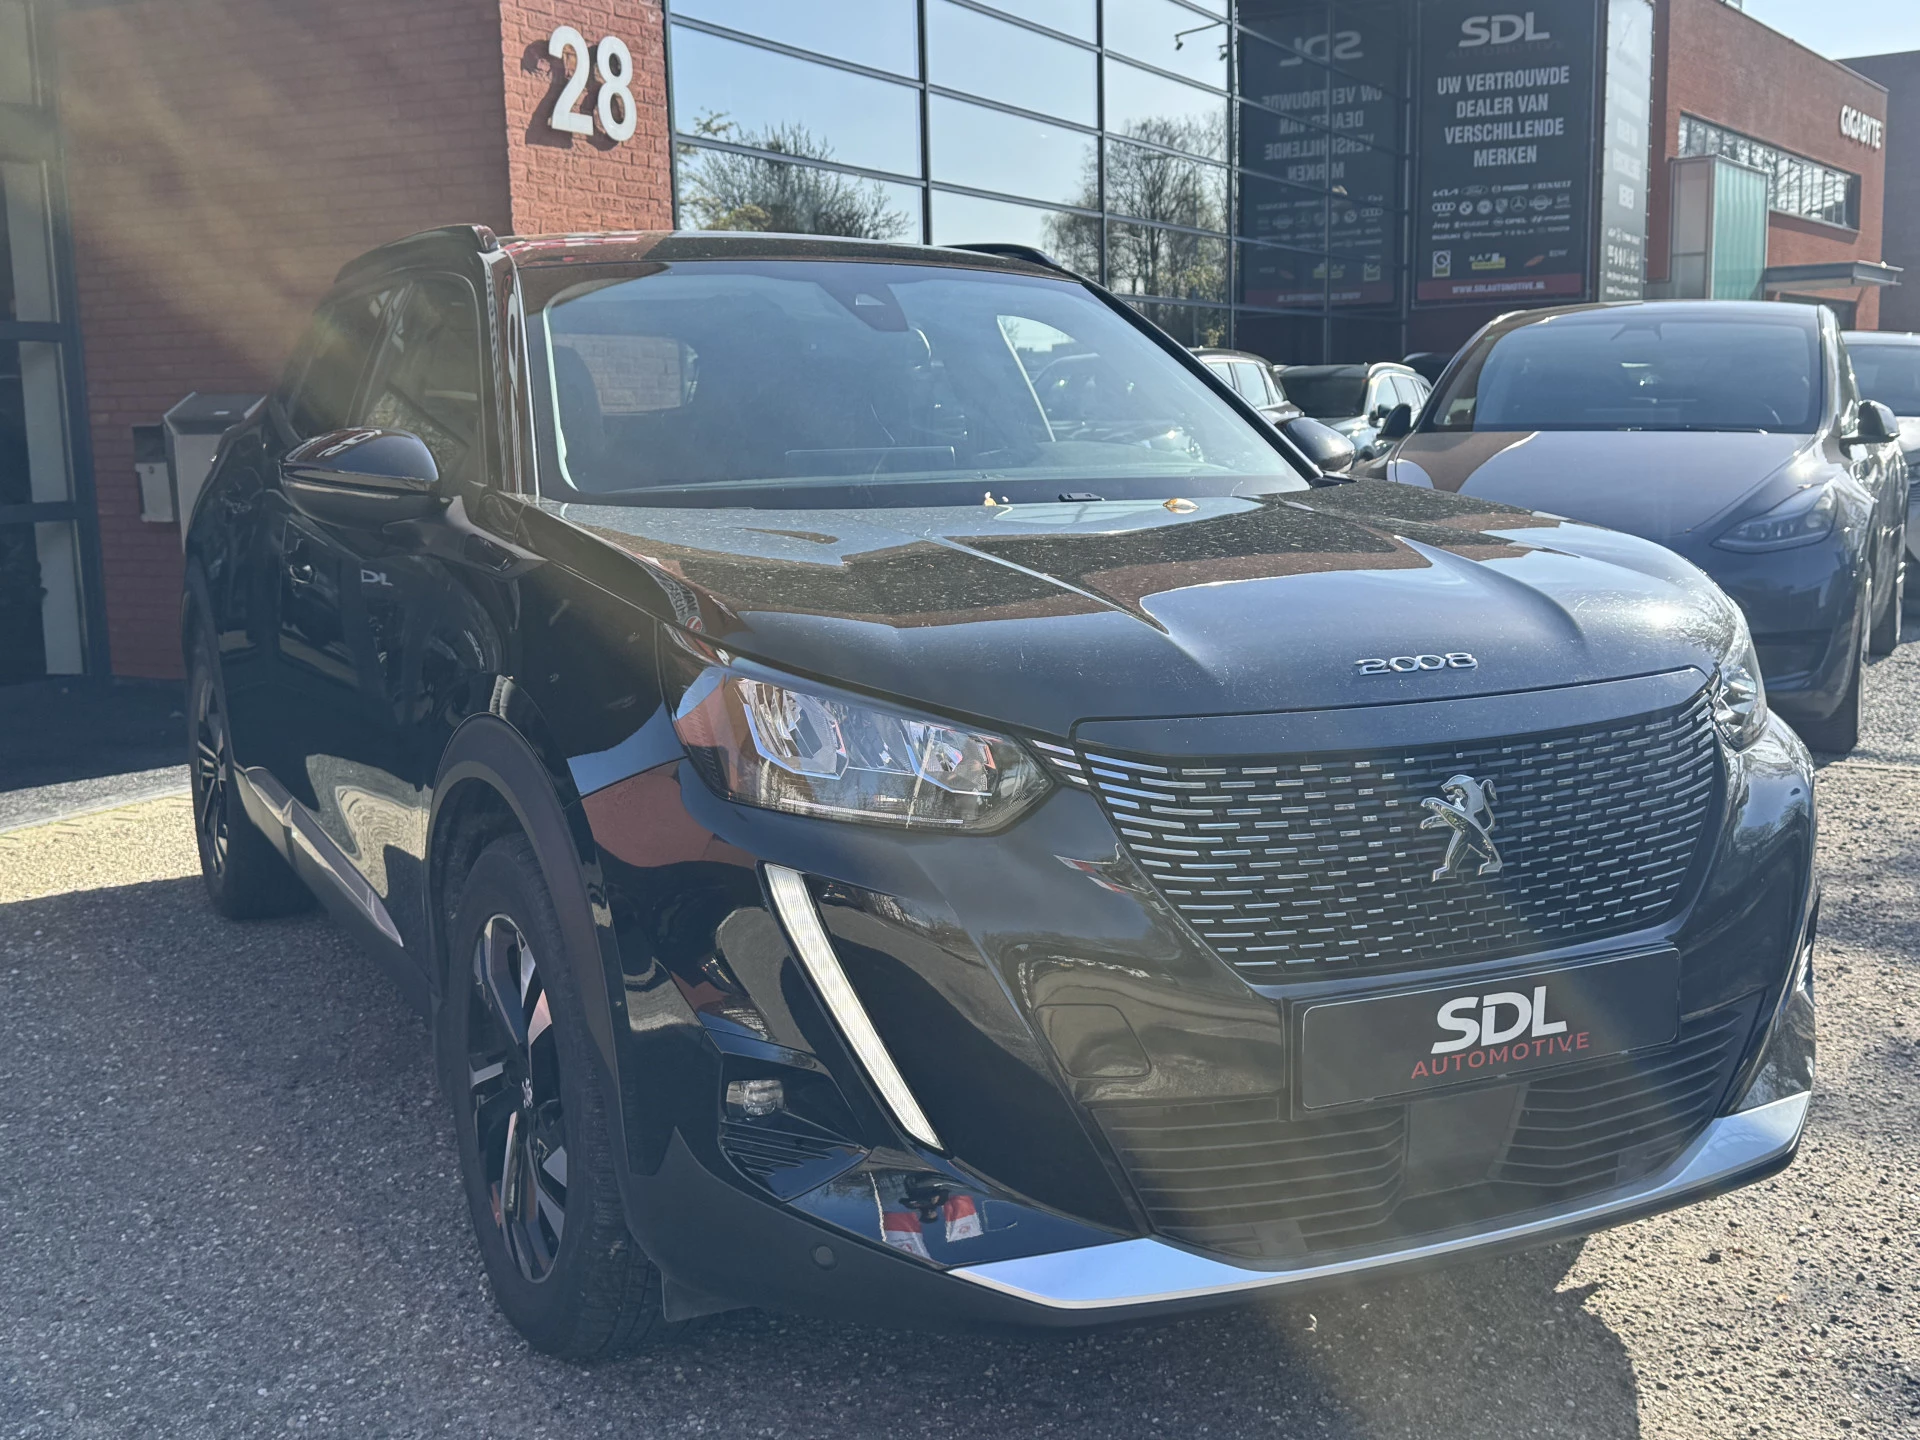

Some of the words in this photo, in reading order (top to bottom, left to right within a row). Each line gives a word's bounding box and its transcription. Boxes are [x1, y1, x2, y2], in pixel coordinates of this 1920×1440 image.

[1458, 11, 1550, 47] SDL
[549, 25, 637, 141] 28
[1437, 75, 1462, 95] UW
[1466, 65, 1570, 93] VERTROUWDE
[1456, 96, 1513, 119] DEALER
[1518, 93, 1549, 114] VAN
[1444, 117, 1565, 145] VERSCHILLENDE
[1841, 104, 1884, 149] GIGABYTE
[1473, 145, 1537, 168] MERKEN
[1354, 652, 1478, 676] 2008
[1430, 985, 1567, 1055] SDL
[1411, 1031, 1590, 1079] AUTOMOTIVE
